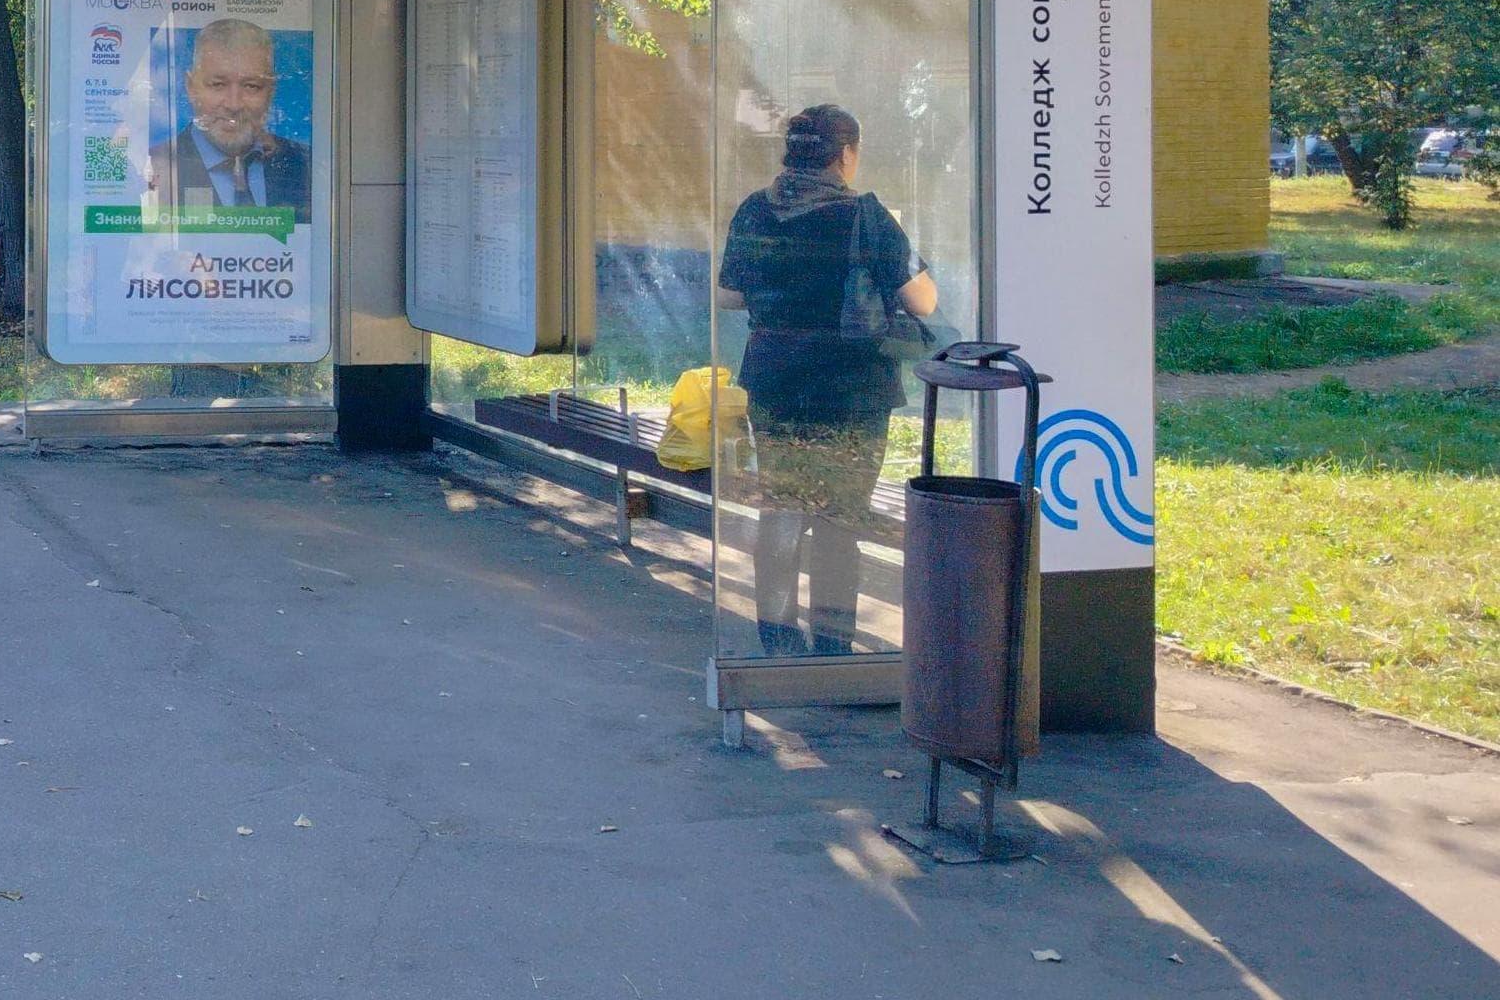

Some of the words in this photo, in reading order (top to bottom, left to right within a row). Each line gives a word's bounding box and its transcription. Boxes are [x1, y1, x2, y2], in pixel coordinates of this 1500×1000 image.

[1027, 57, 1055, 215] Колледж
[1094, 114, 1112, 208] Kolledzh
[207, 213, 285, 229] Результат.
[190, 251, 294, 274] Алексей
[125, 278, 294, 300] ЛИСОВЕНКО
